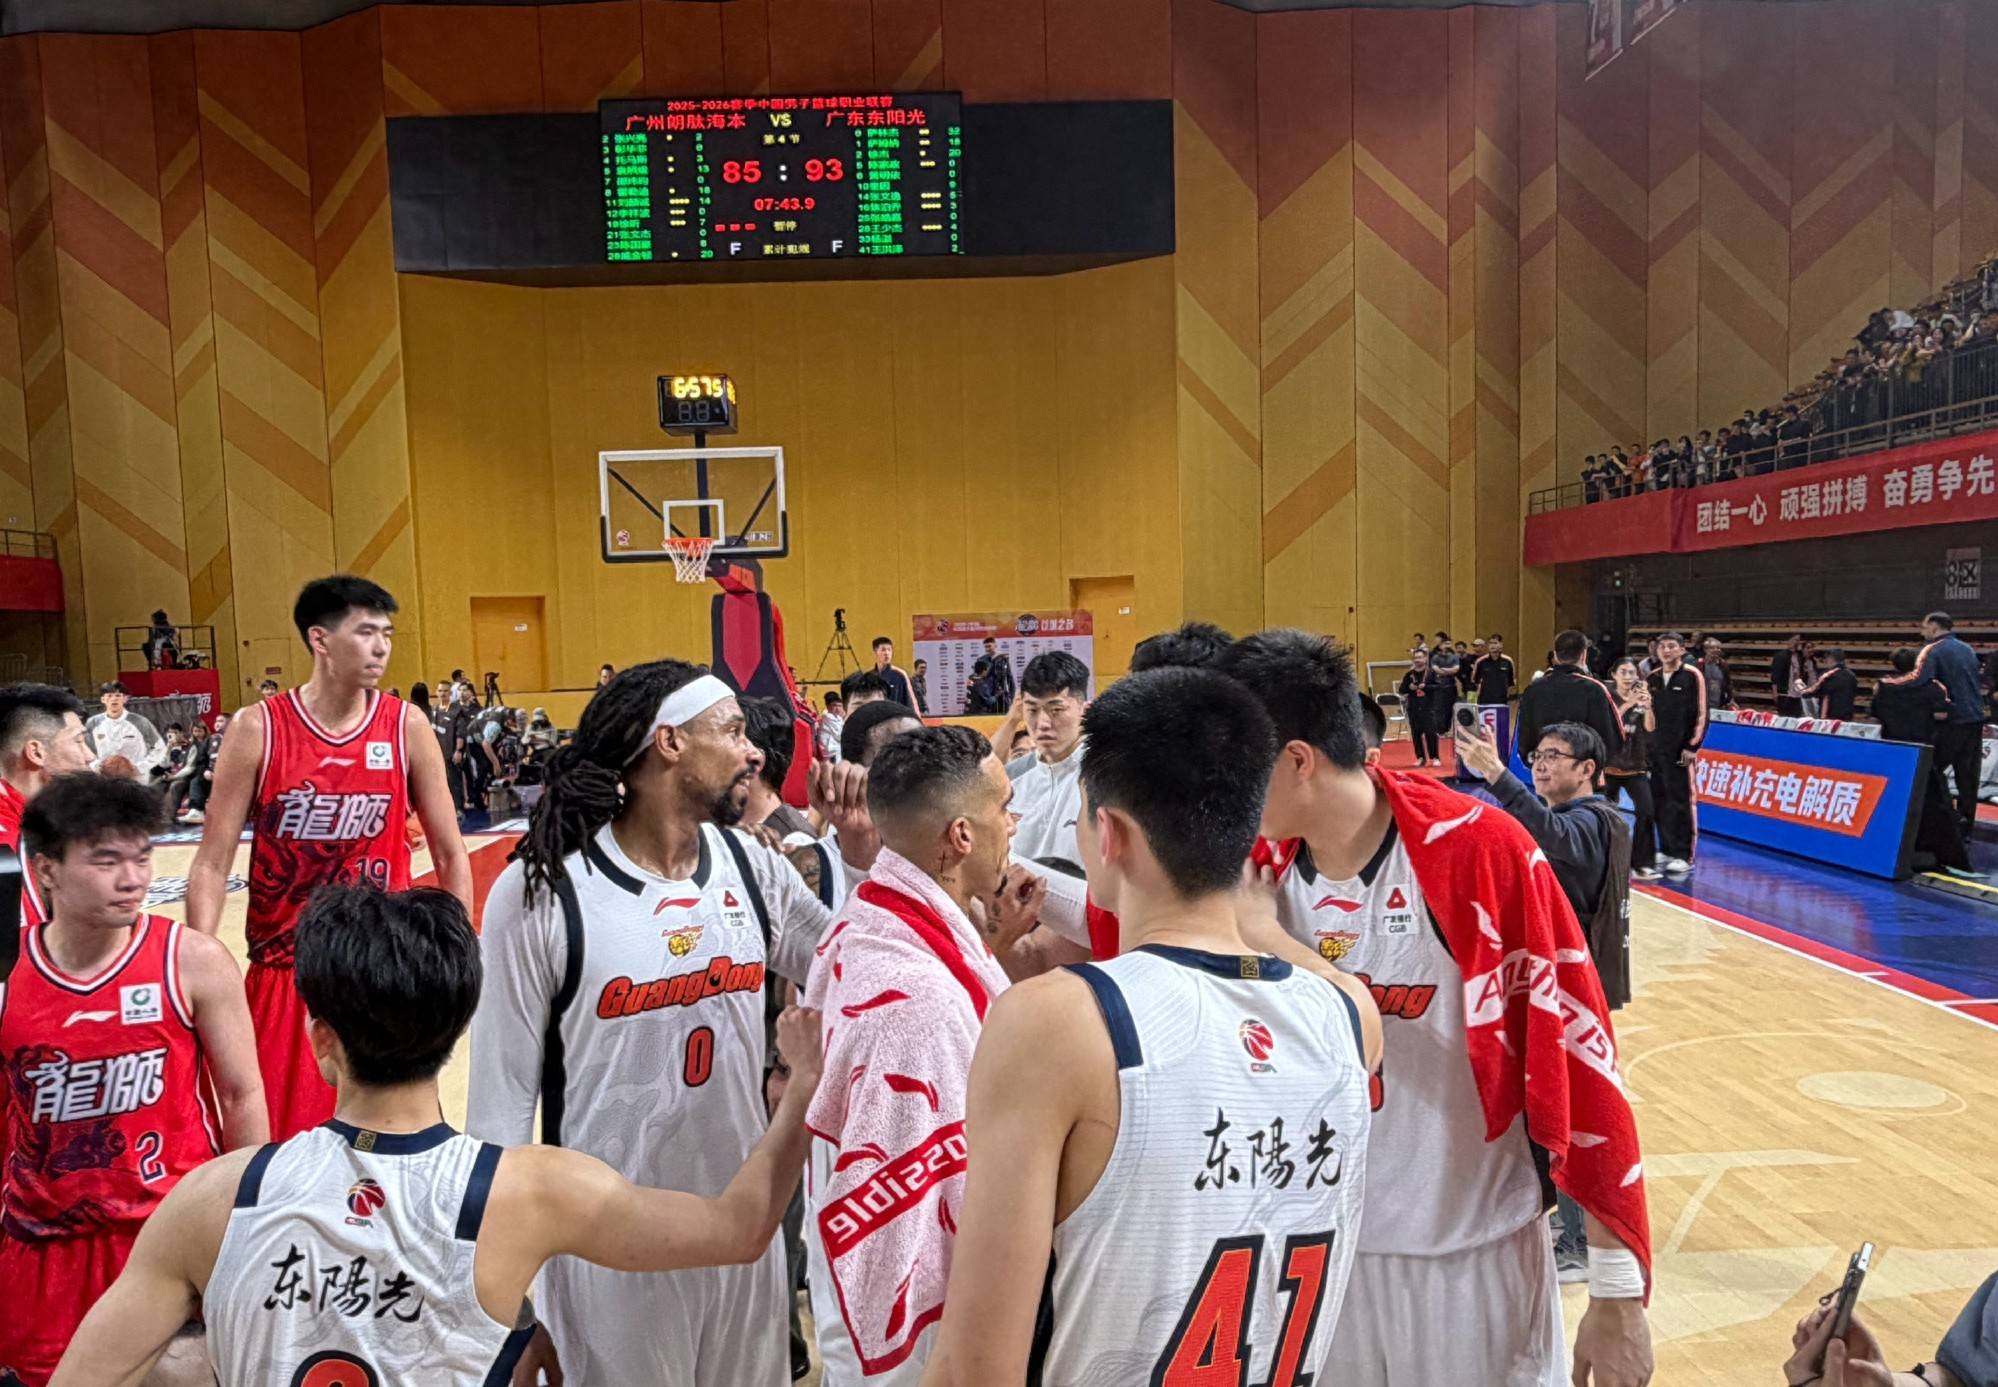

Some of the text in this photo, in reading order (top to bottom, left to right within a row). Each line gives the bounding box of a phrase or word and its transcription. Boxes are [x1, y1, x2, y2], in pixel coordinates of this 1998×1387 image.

[625, 113, 746, 131] 广州朗肽海本
[770, 112, 792, 127] VS
[826, 109, 926, 127] 广东东阳光
[723, 161, 762, 184] 85
[805, 159, 843, 182] 93
[754, 198, 815, 211] 07:43.9
[730, 242, 741, 255] F
[832, 240, 843, 253] F
[1697, 454, 1996, 533] 团结一心 顽强拼搏 奋勇争先
[683, 1025, 716, 1088] 0
[134, 1130, 168, 1185] 2
[1148, 1229, 1336, 1387] 41
